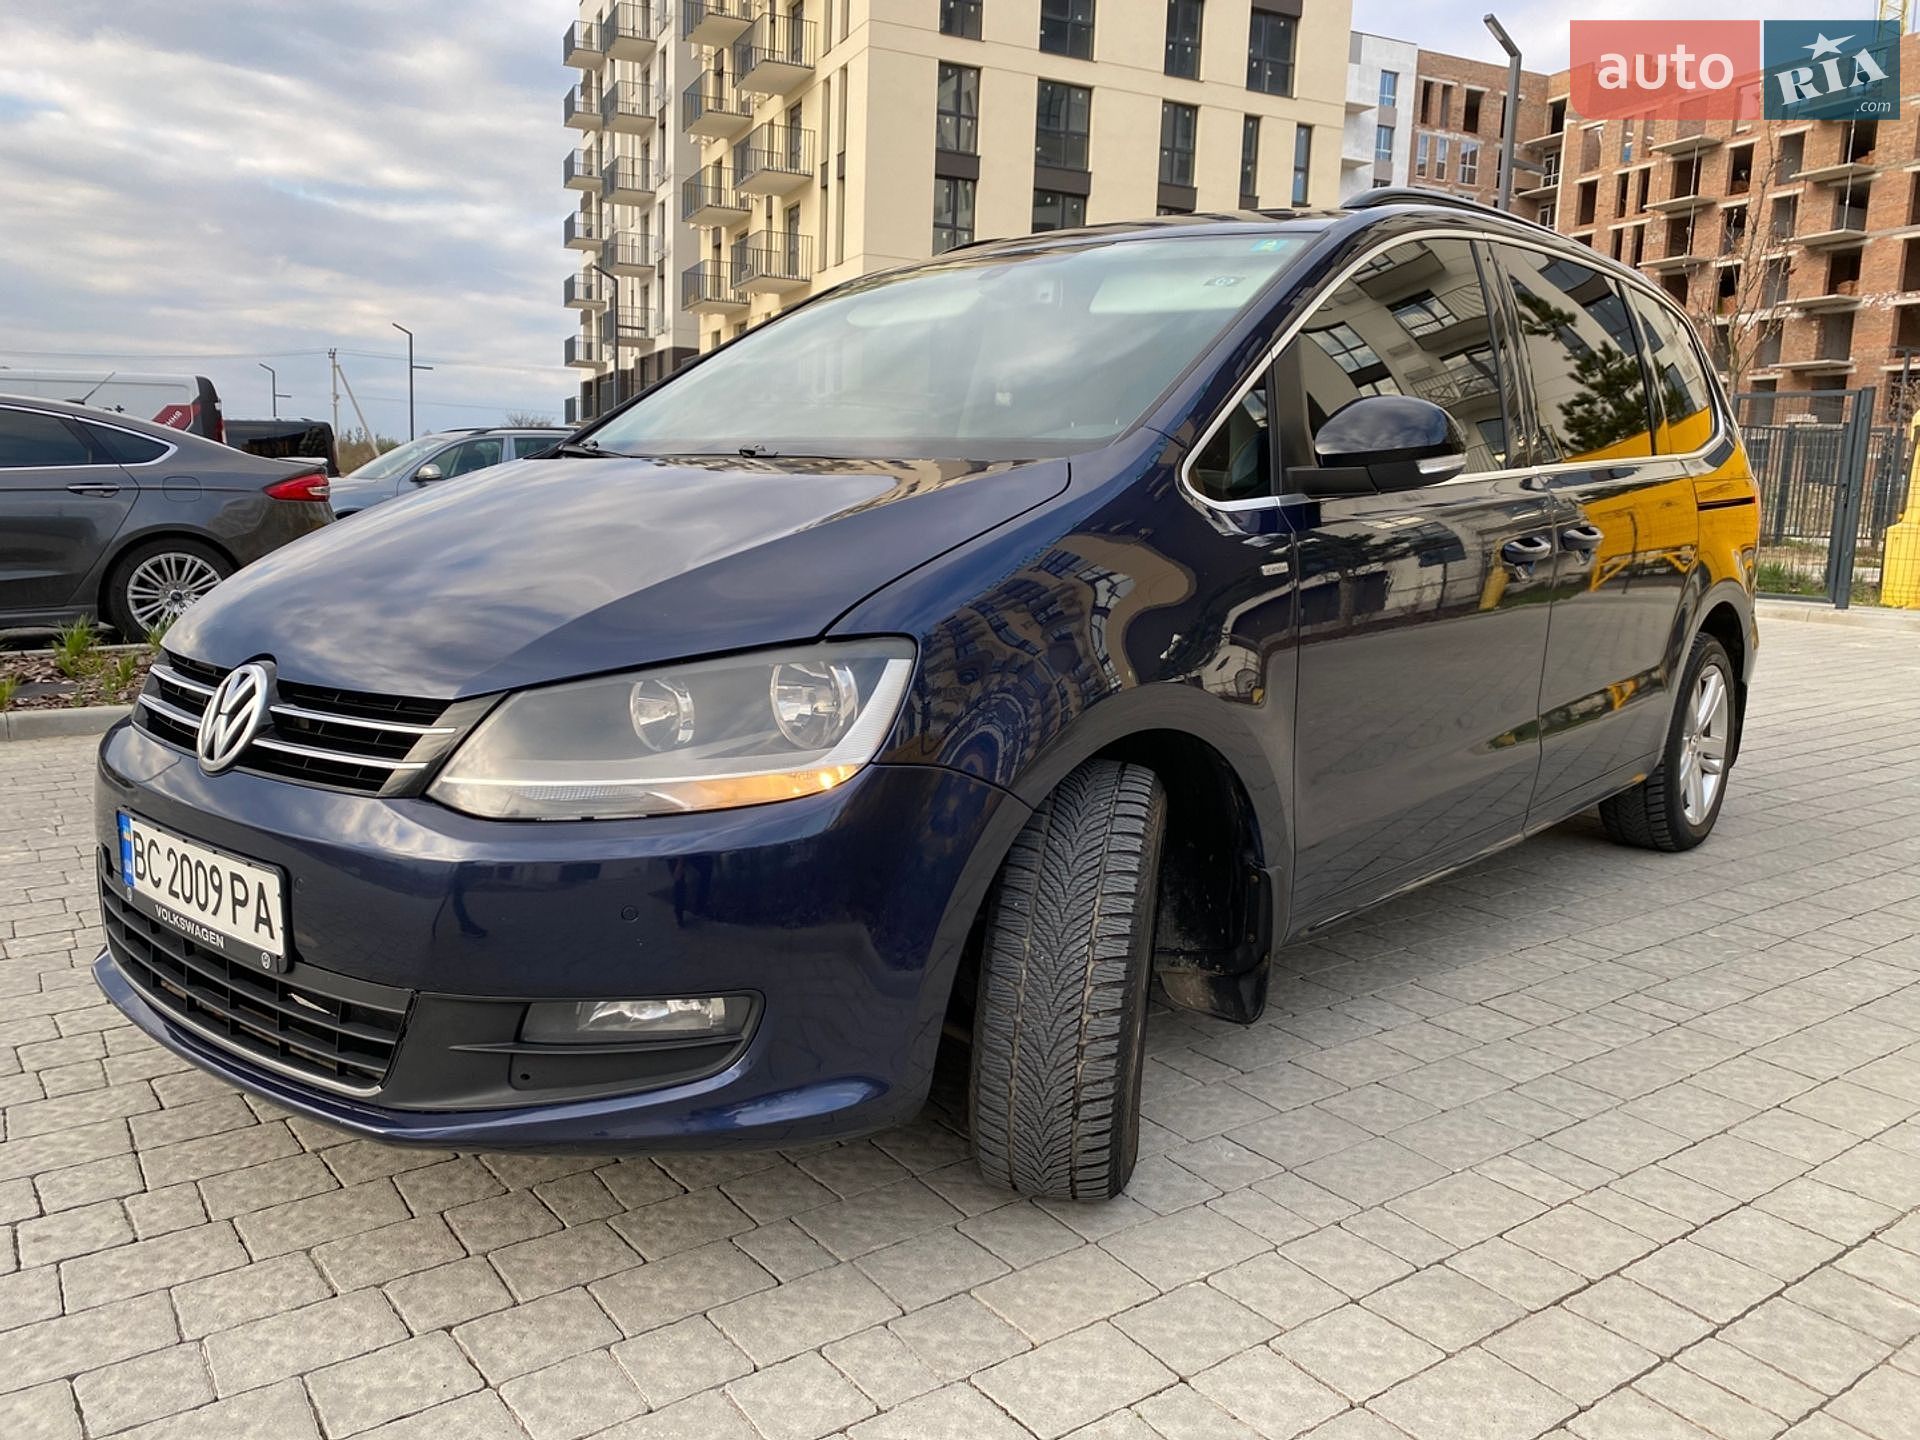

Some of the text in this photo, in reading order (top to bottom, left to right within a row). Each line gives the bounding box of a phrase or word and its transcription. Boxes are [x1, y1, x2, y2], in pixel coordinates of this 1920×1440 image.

[133, 830, 275, 940] BC 2009 PA
[155, 903, 224, 949] VOLKSWAGEN
